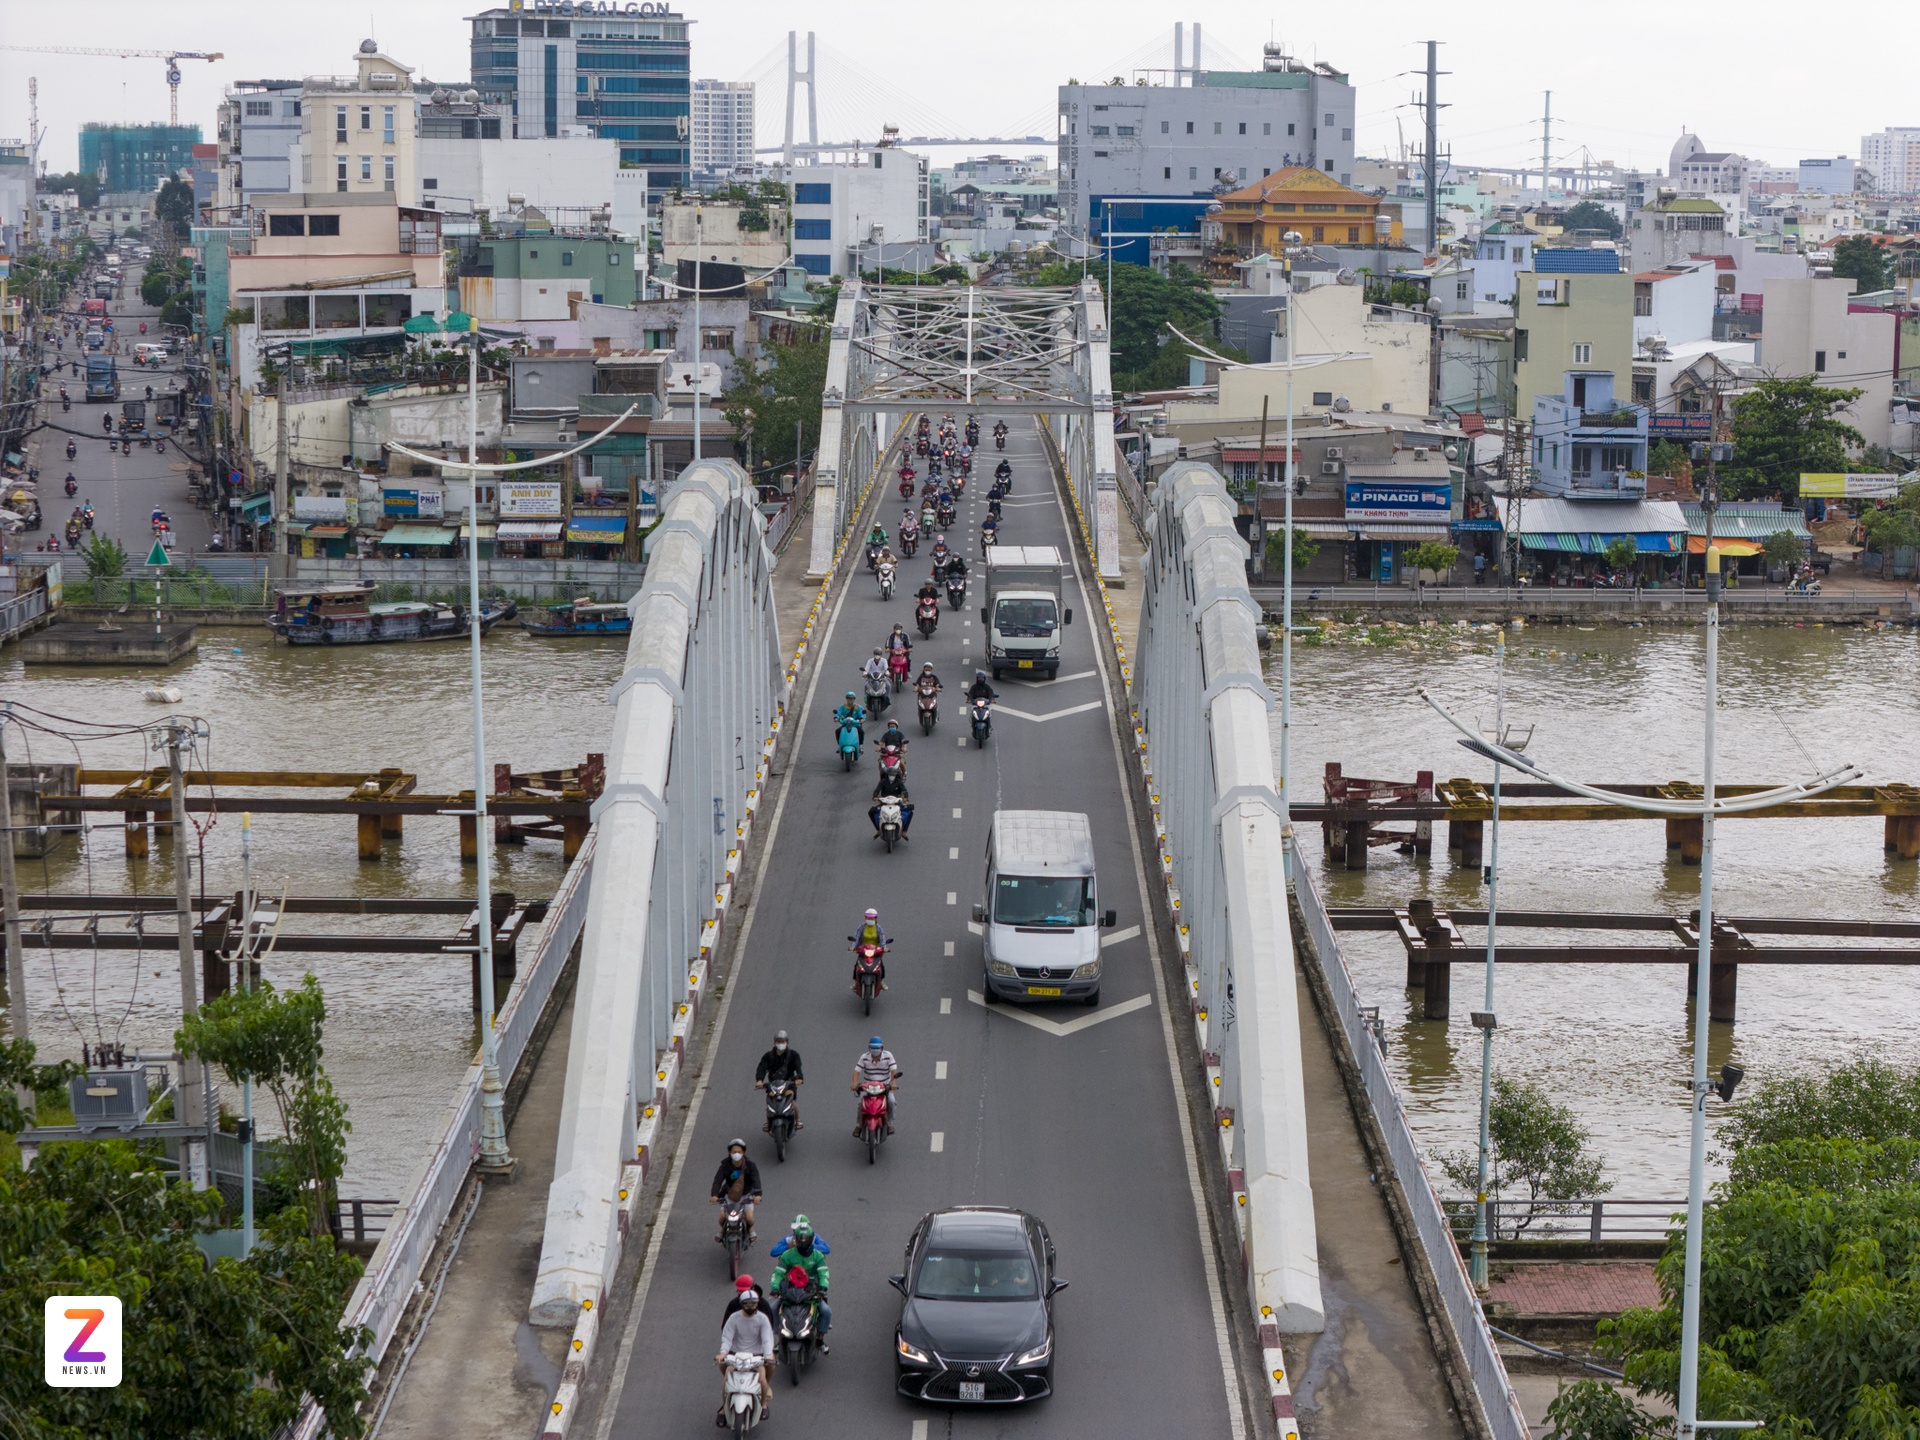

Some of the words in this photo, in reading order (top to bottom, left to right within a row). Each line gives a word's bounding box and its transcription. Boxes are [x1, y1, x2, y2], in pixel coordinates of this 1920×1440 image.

[1656, 419, 1683, 427] MINH
[420, 494, 440, 504] PHÁT
[1363, 493, 1419, 502] PINACO
